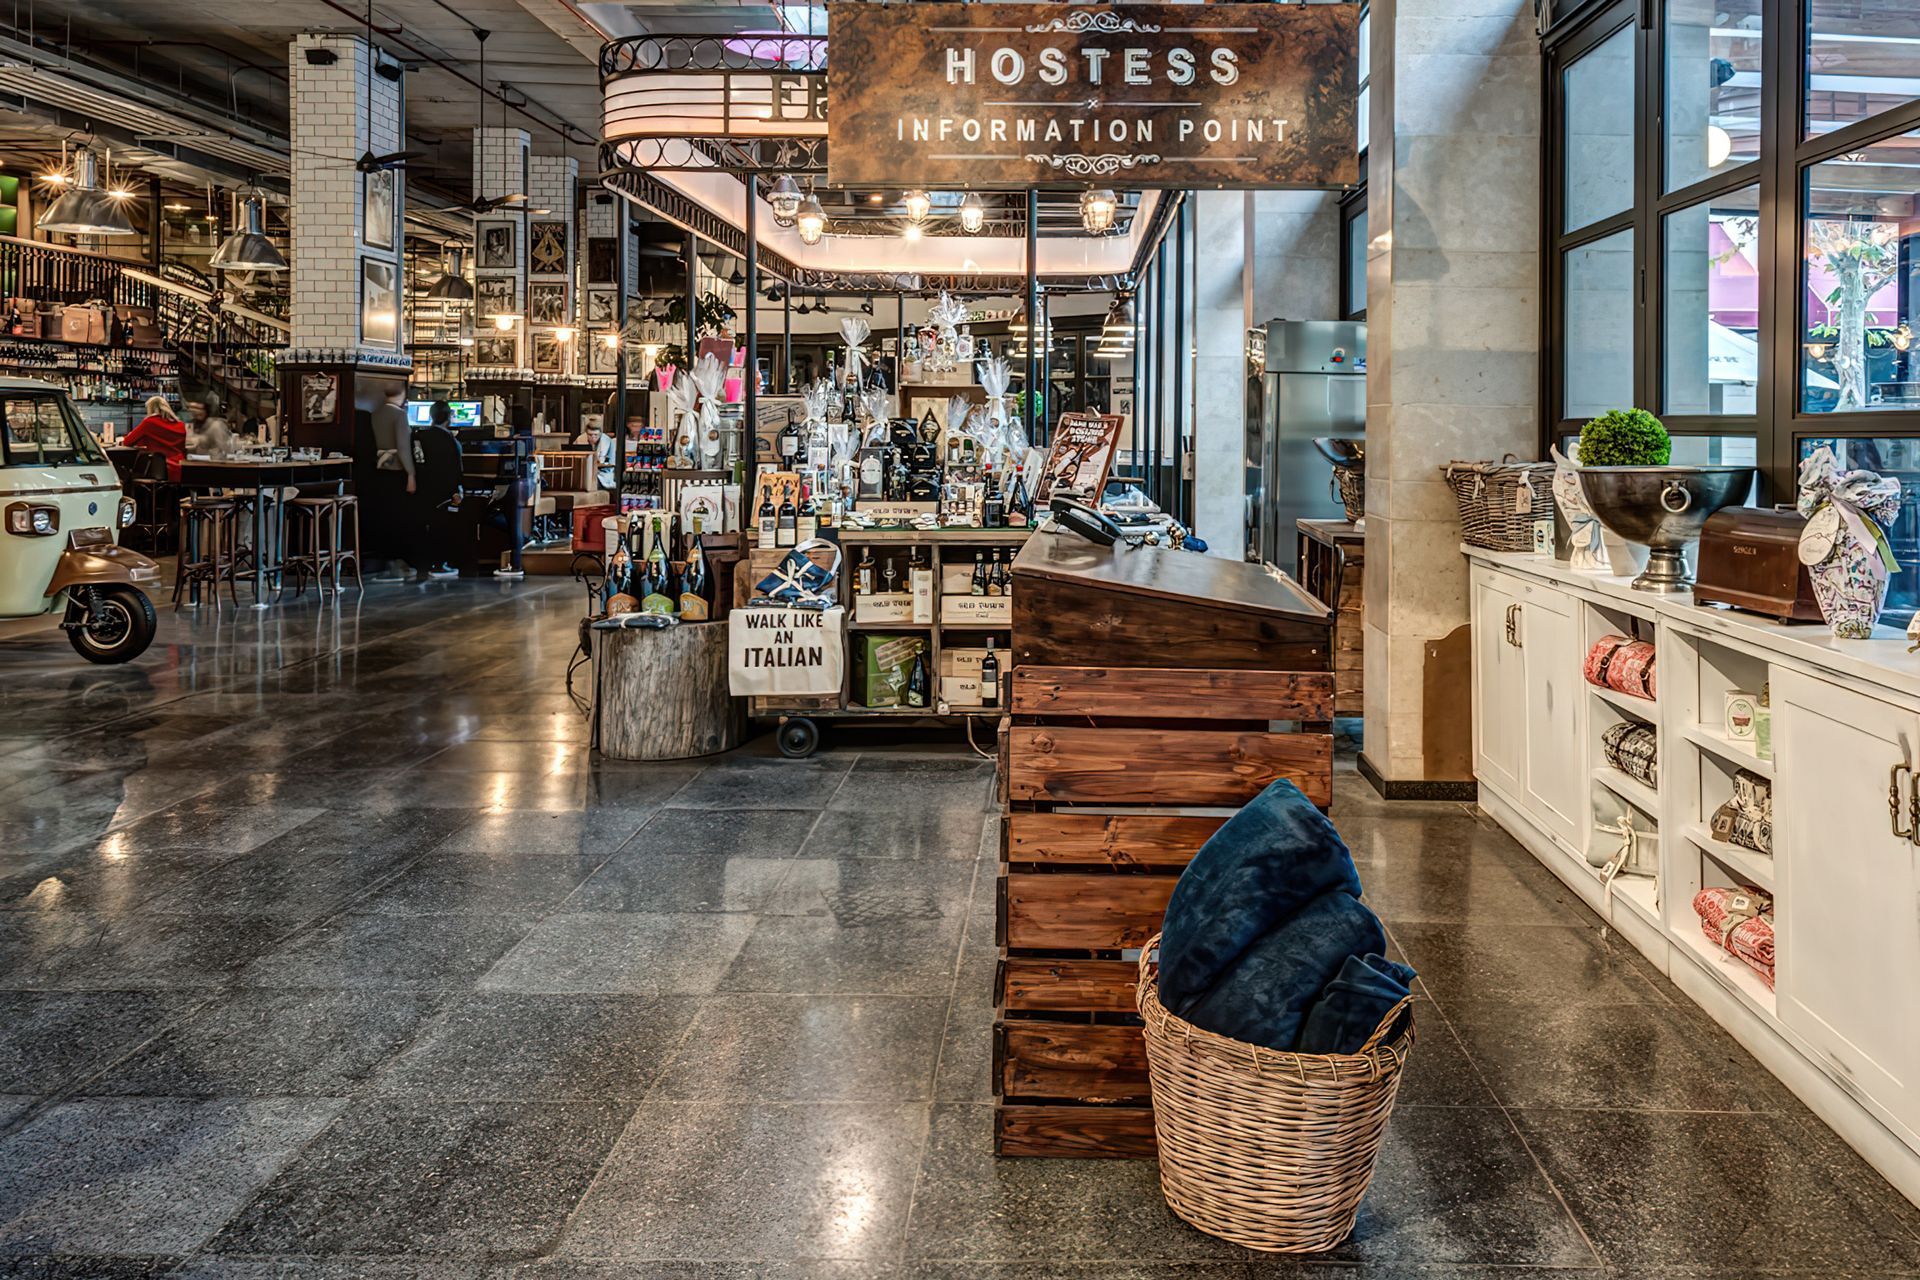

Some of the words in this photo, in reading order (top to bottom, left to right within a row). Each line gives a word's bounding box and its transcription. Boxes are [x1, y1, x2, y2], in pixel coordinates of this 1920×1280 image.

[945, 47, 1240, 86] HOSTESS
[897, 118, 1154, 143] INFORMATION
[1179, 118, 1290, 143] POINT
[745, 613, 787, 629] WALK
[793, 613, 824, 628] LIKE
[774, 630, 793, 645] AN
[744, 646, 823, 668] ITALIAN
